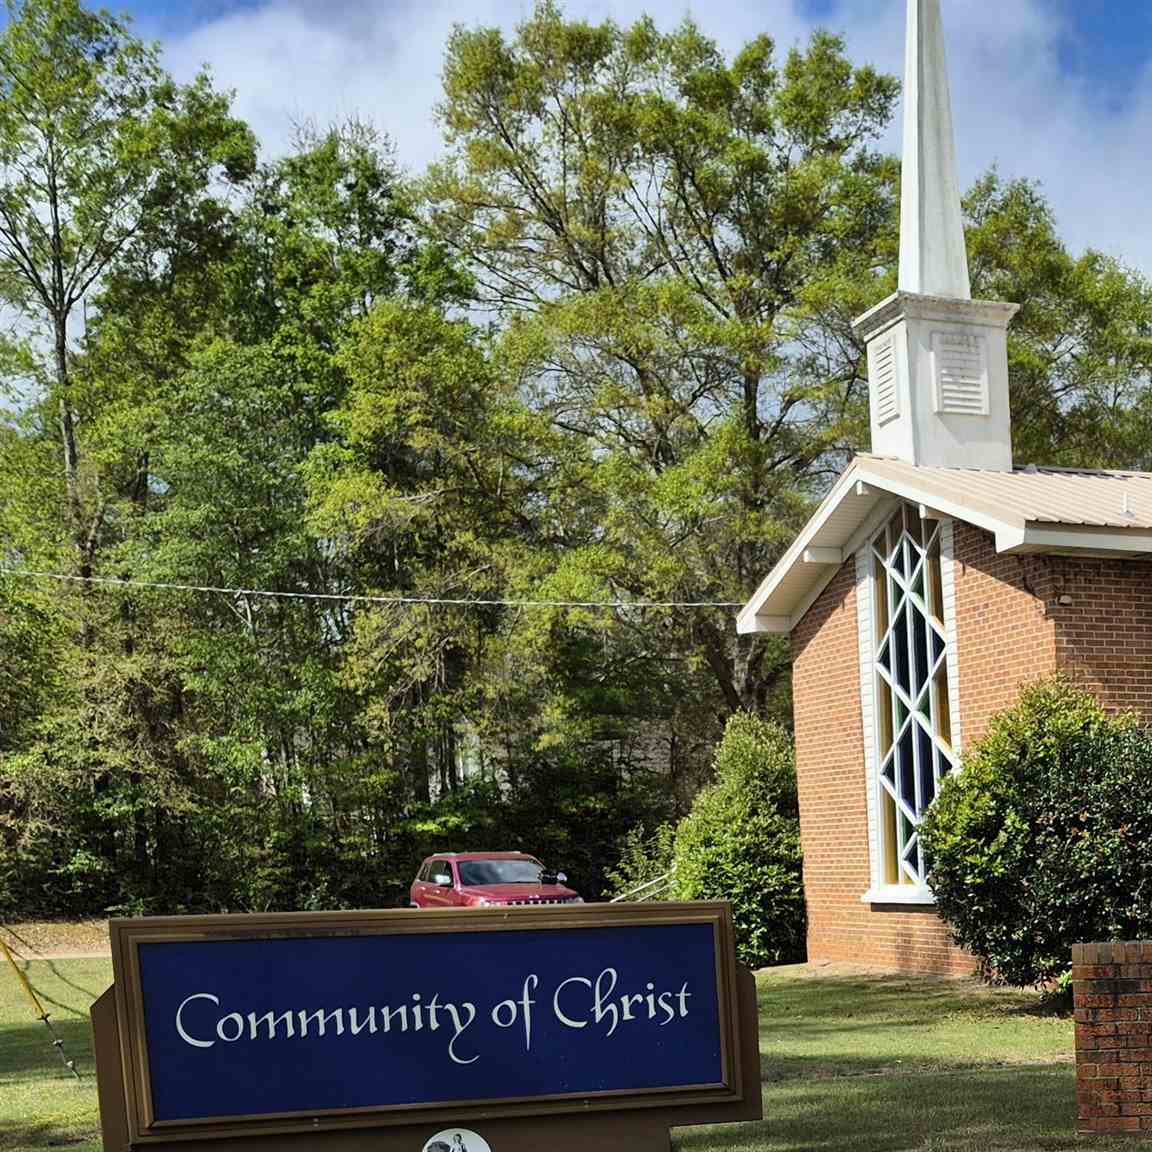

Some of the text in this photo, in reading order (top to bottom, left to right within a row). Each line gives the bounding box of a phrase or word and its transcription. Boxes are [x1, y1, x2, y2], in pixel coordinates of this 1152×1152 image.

[175, 967, 691, 1064] Community of Christ
